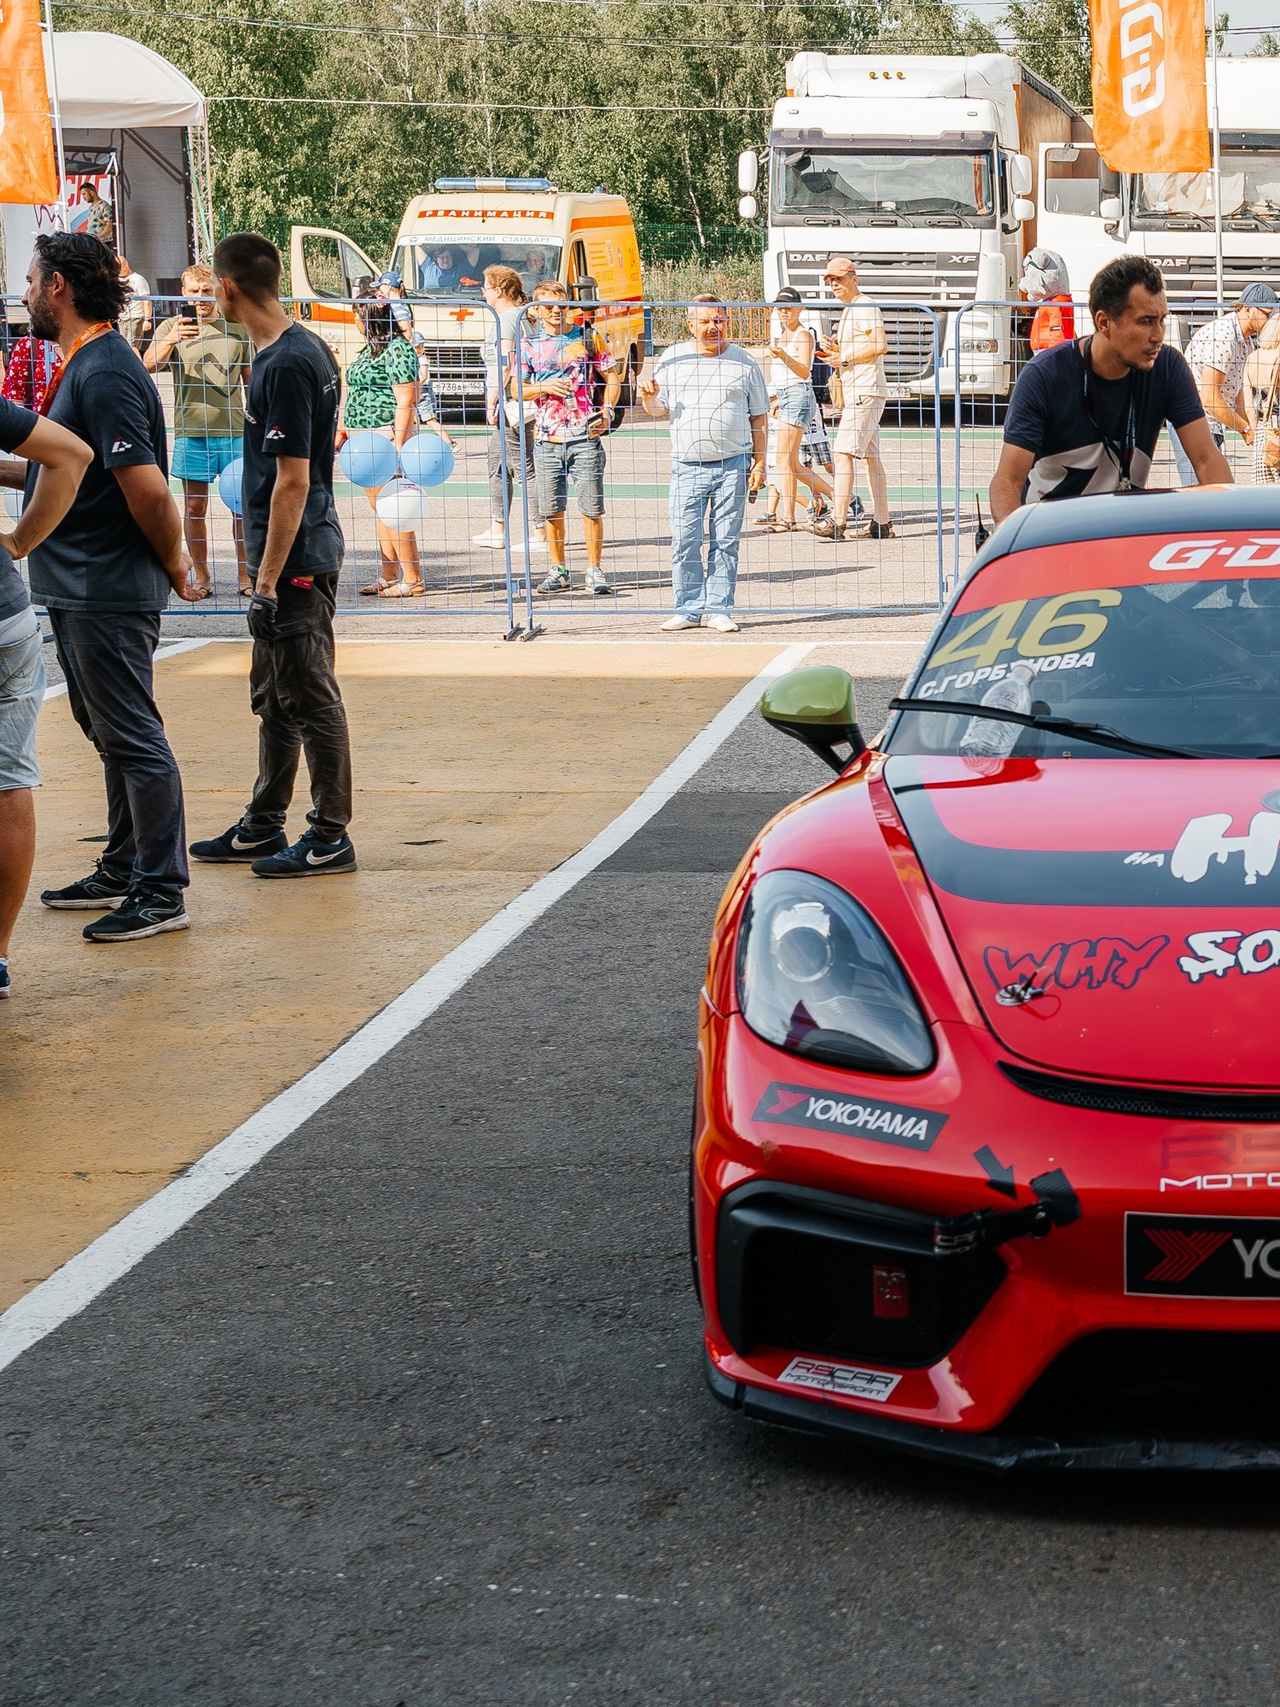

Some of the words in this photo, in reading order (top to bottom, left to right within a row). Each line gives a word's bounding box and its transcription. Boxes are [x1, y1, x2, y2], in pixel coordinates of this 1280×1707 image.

[425, 210, 547, 219] РЕАНИМАЦИЯ
[424, 235, 496, 243] МЕДИЦИНСКИЙ
[789, 253, 830, 262] DAF
[948, 255, 977, 264] XF
[1150, 258, 1189, 267] DAF
[927, 588, 1123, 670] 46
[1123, 851, 1165, 867] HA
[983, 934, 1170, 990] WHY
[805, 1096, 929, 1141] YOKOHAMA
[791, 1360, 895, 1388] RSCAR
[785, 1372, 886, 1396] MOTORSPORT
